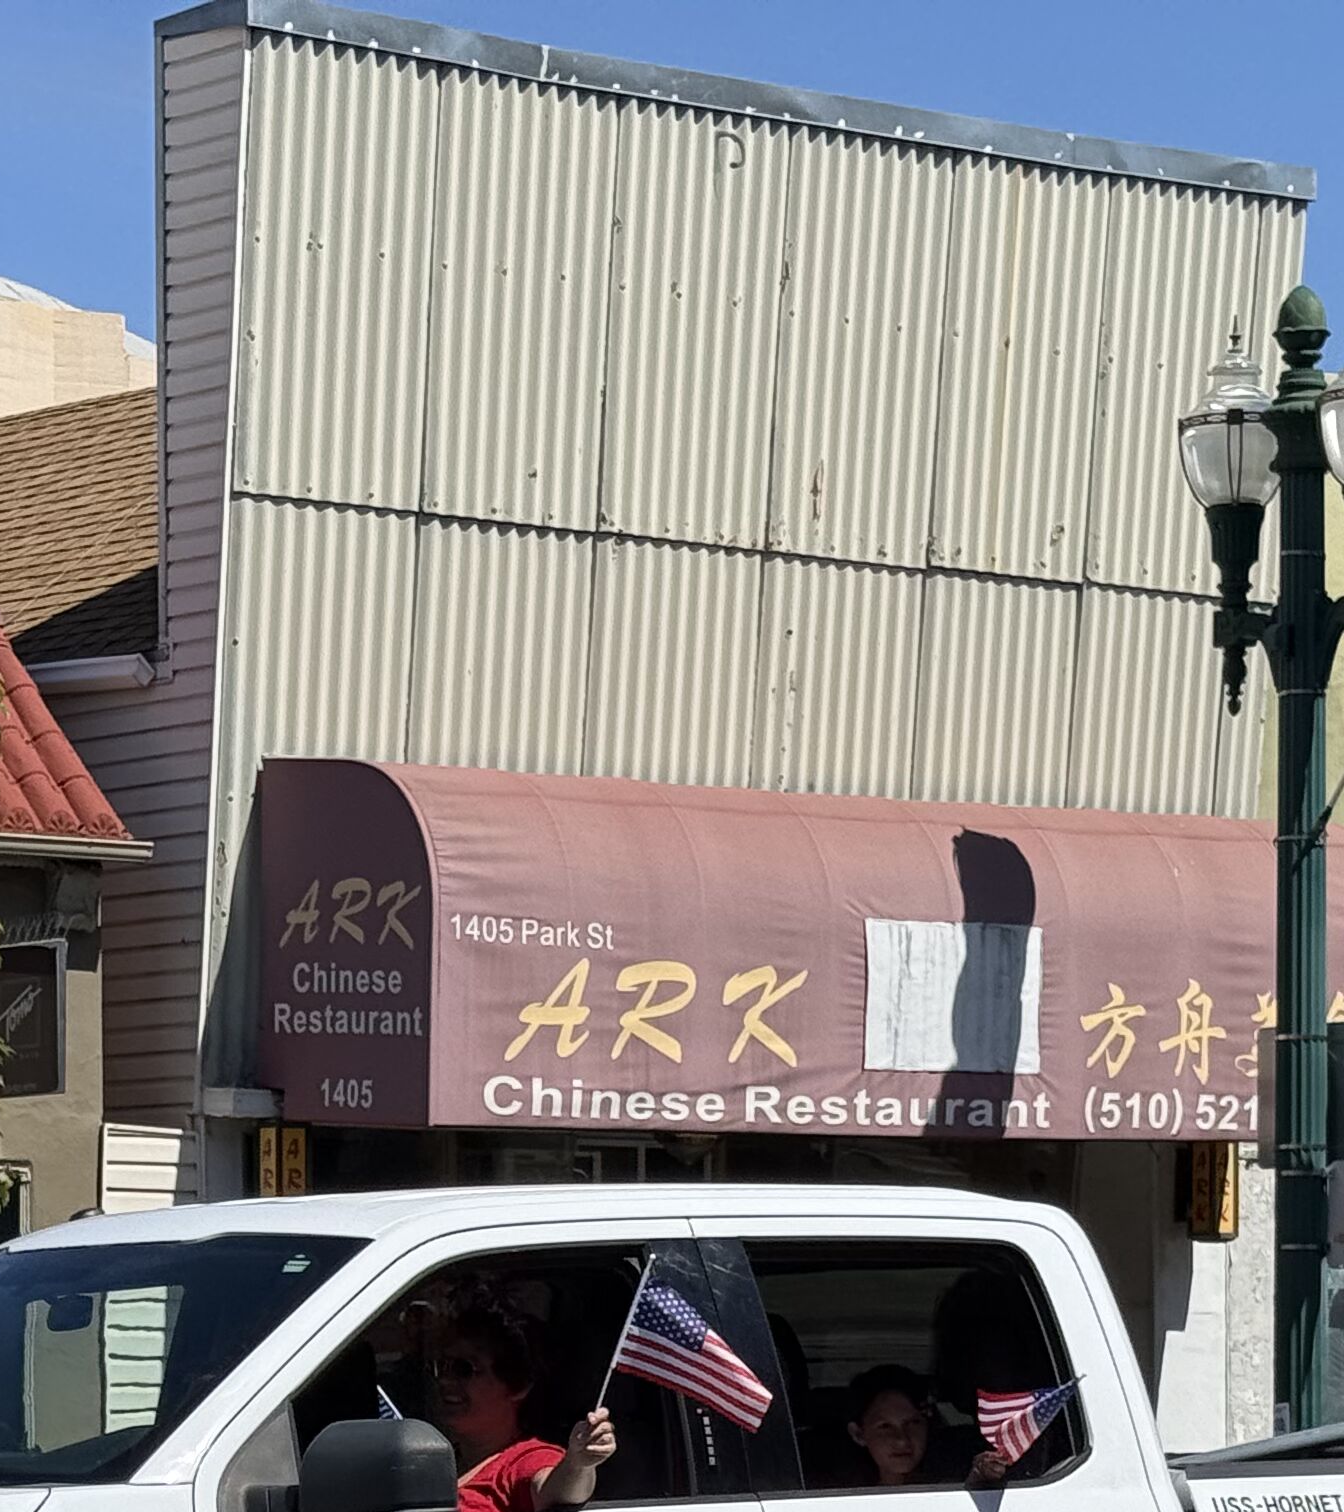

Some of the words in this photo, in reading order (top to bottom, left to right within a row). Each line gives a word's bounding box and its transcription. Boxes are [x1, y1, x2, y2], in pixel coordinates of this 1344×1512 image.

[280, 876, 422, 950] ARK
[450, 913, 514, 943] 1405
[522, 919, 579, 948] Park
[587, 922, 615, 951] St
[292, 962, 403, 995] Chinese
[274, 1002, 423, 1037] Restaurant
[503, 957, 809, 1068] ARK
[320, 1079, 373, 1109] 1405
[483, 1075, 725, 1122] Chinese
[744, 1085, 1051, 1131] Restaurant
[1084, 1086, 1184, 1136] (510)
